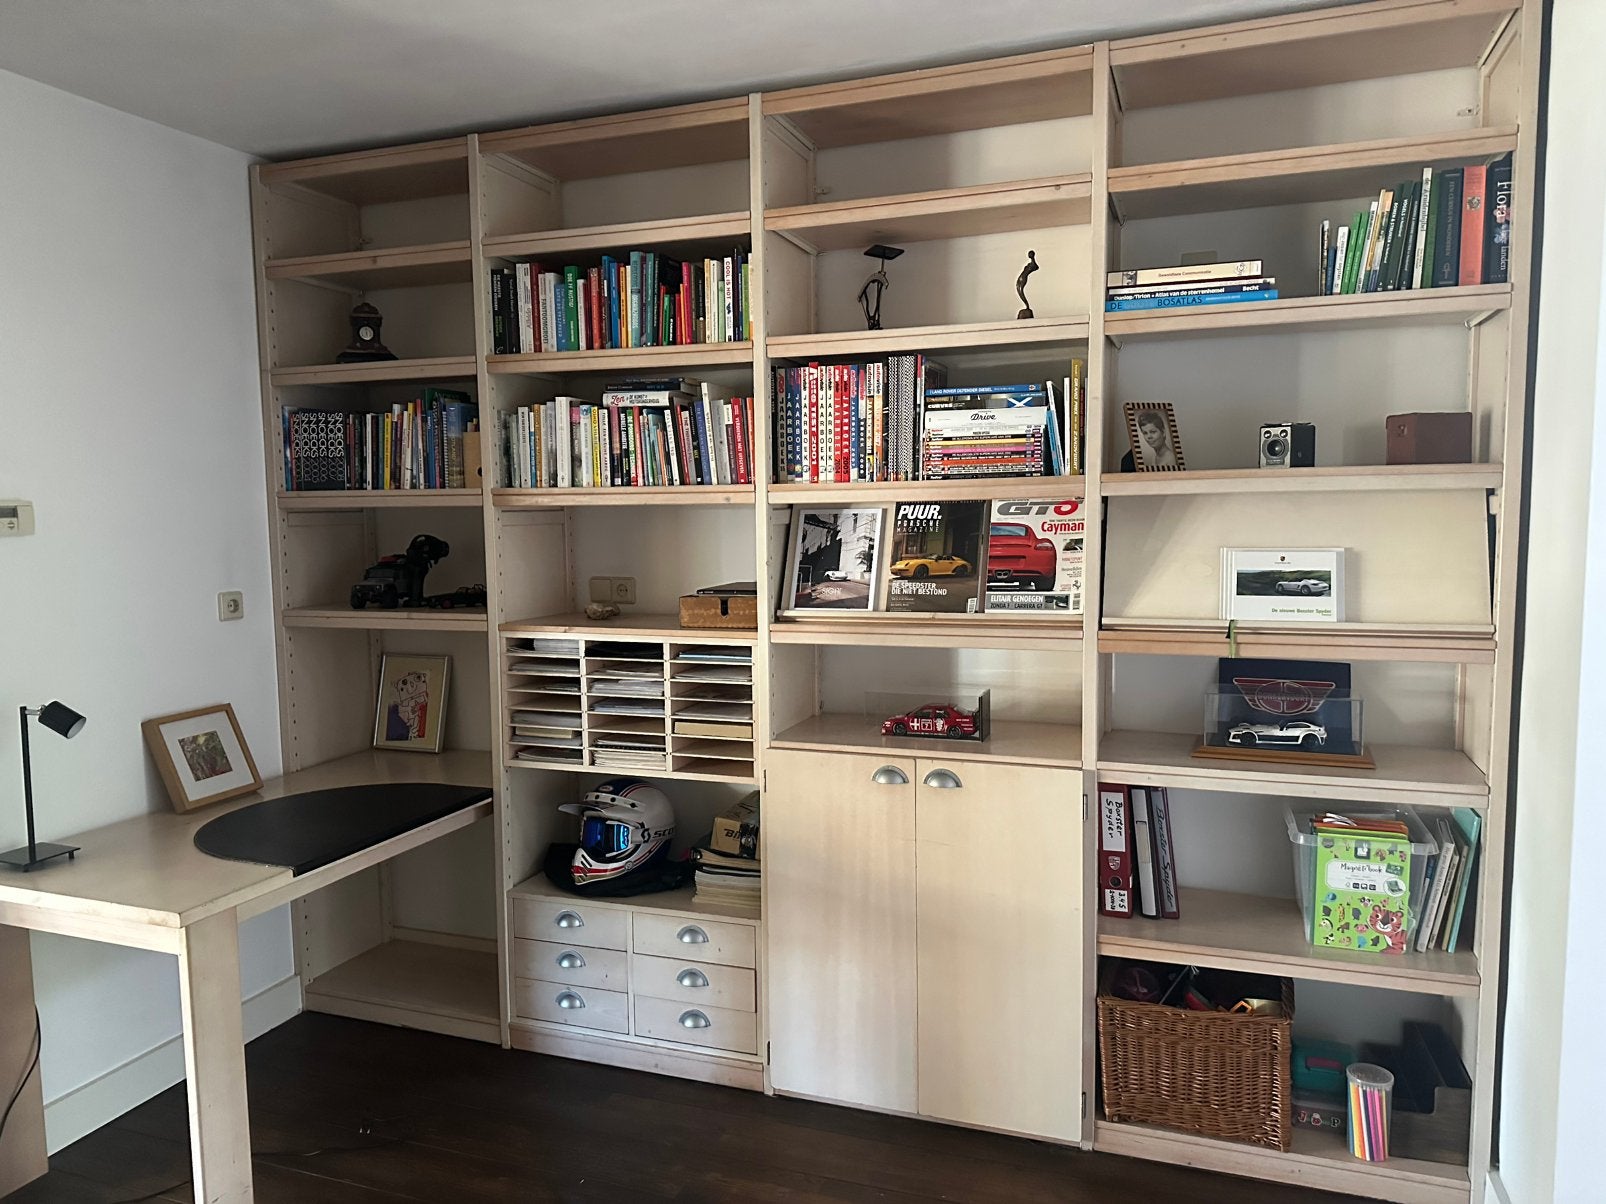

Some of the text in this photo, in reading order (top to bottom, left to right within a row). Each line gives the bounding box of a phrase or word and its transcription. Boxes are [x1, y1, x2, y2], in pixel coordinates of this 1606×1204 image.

[1400, 198, 1409, 216] VOGELS
[1387, 222, 1395, 243] STRUIKEN
[1496, 182, 1512, 270] Flora landen
[1188, 287, 1225, 295] sterrenhemel
[1157, 296, 1203, 307] BOSATLAS
[611, 395, 625, 405] Zen
[971, 412, 996, 421] Drive
[293, 414, 301, 457] SNOECKS
[301, 413, 310, 457] SNOECKS
[309, 413, 318, 458] SNOECKS
[318, 412, 327, 457] SNOECKS
[328, 414, 336, 457] SNOECKS
[335, 413, 344, 457] SNOECKS
[897, 504, 942, 519] PUUR.
[897, 520, 940, 528] PORSCHE
[1041, 521, 1085, 535] Cayman
[902, 582, 937, 590] SPEEDSTER
[1012, 595, 1044, 603] GENOEGEN
[1106, 798, 1114, 838] Spyder
[1115, 801, 1123, 836] Boxster
[1155, 806, 1174, 907] Boxster Spyder
[1331, 1116, 1342, 1127] P
